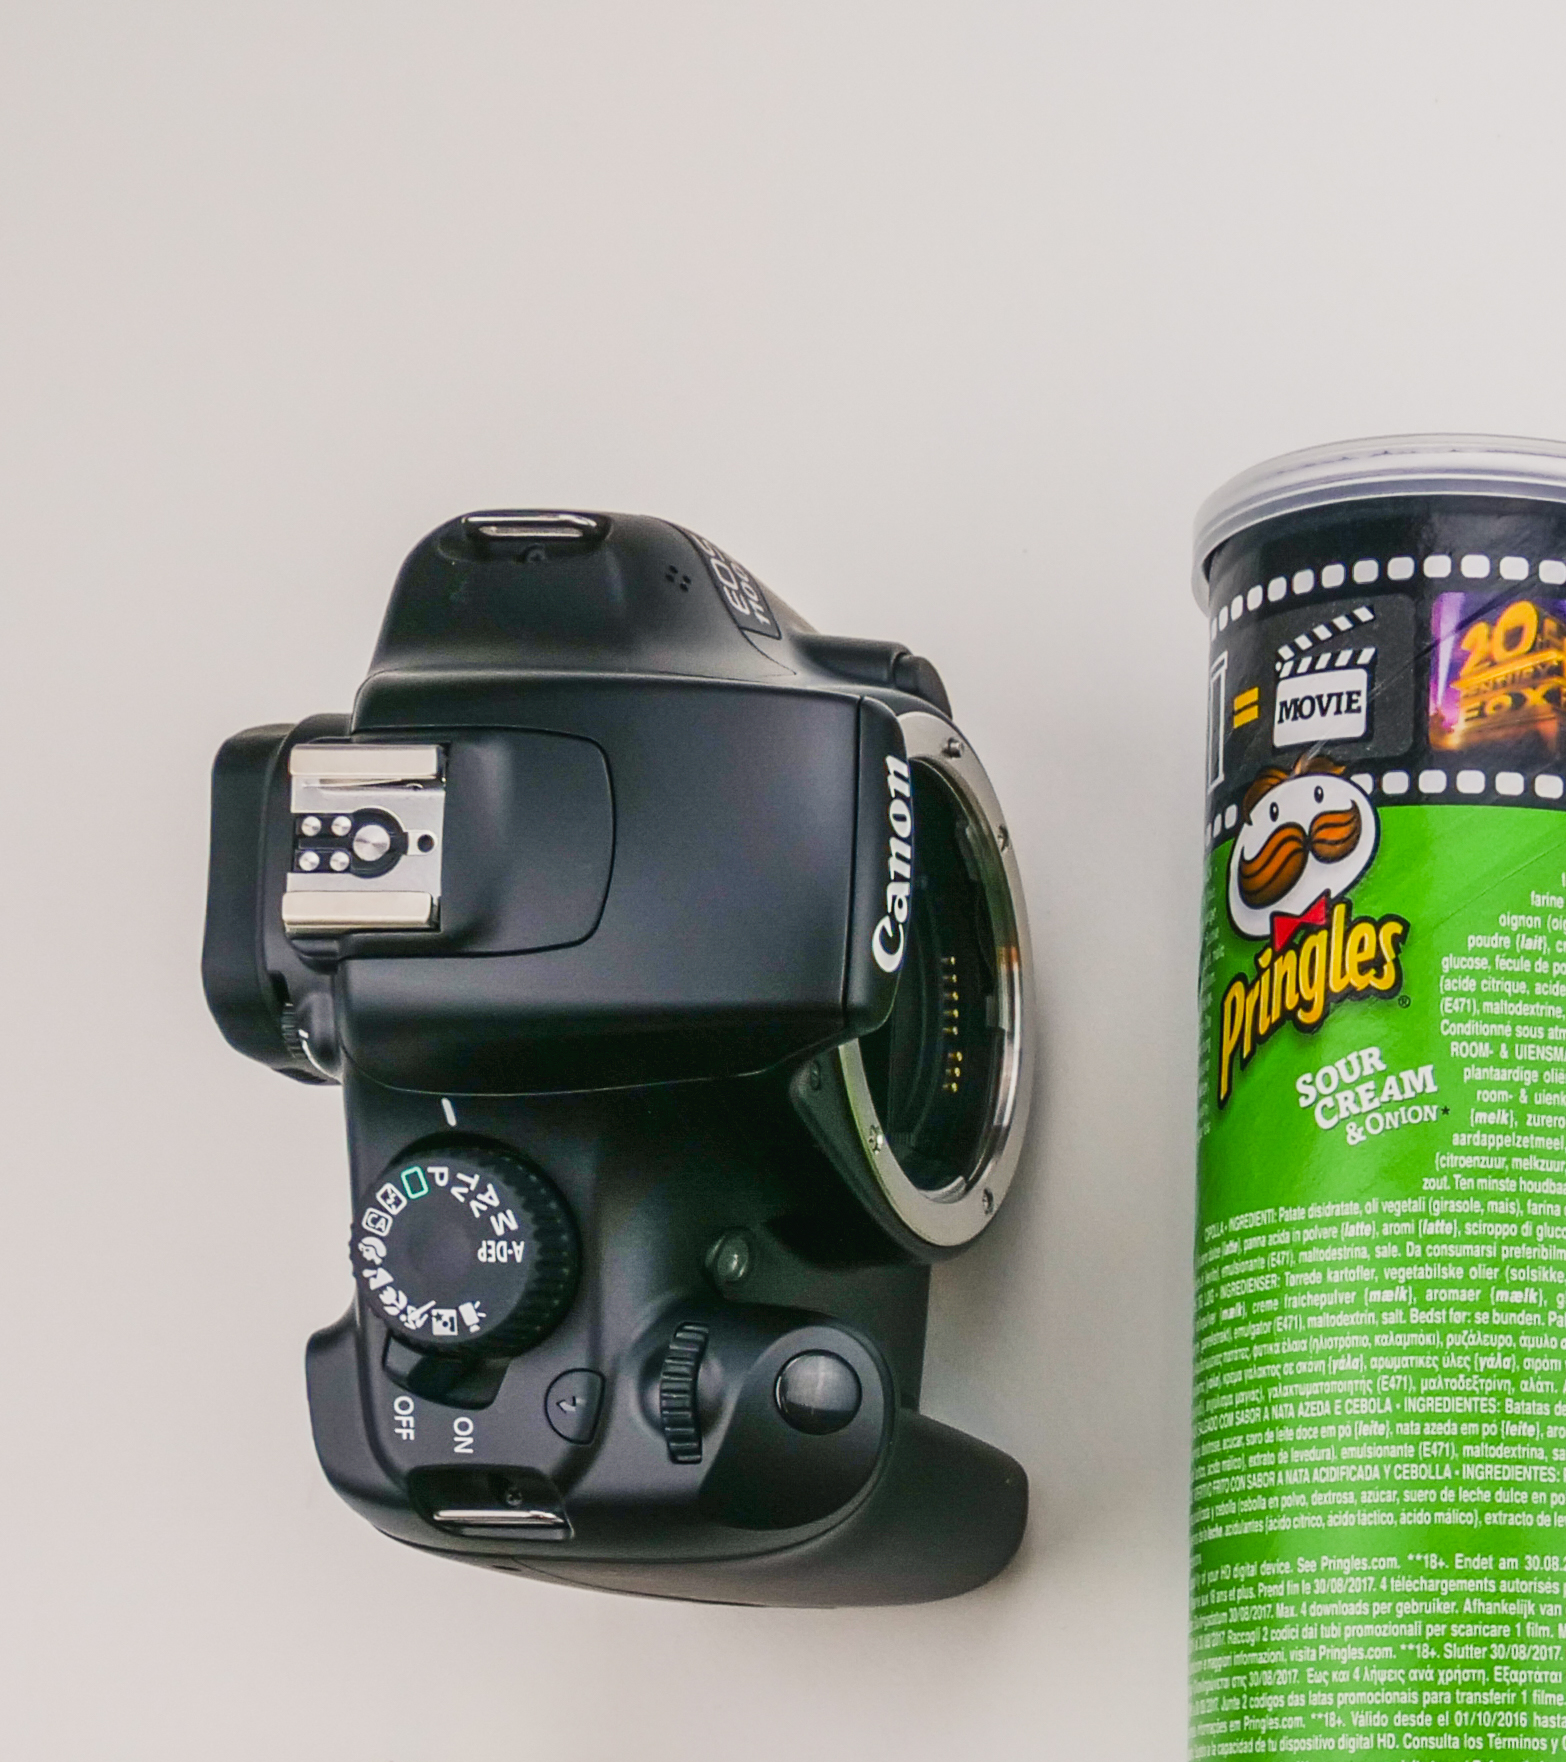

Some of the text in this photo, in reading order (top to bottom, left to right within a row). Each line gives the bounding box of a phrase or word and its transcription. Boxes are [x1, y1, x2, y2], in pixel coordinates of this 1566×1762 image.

[1277, 690, 1362, 724] MOVIE
[872, 755, 912, 973] Canon
[1218, 901, 1405, 1103] Pringles
[1295, 1046, 1387, 1109] SOUR
[1314, 1064, 1439, 1131] CREAM
[1345, 1121, 1367, 1146] &
[427, 1166, 449, 1187] P
[450, 1172, 480, 1203] Tv
[469, 1183, 500, 1219] Av
[490, 1209, 519, 1236] M
[477, 1240, 525, 1263] A-DEP
[393, 1395, 415, 1441] OFF
[453, 1416, 474, 1454] ON
[1455, 1553, 1494, 1571] Endet
